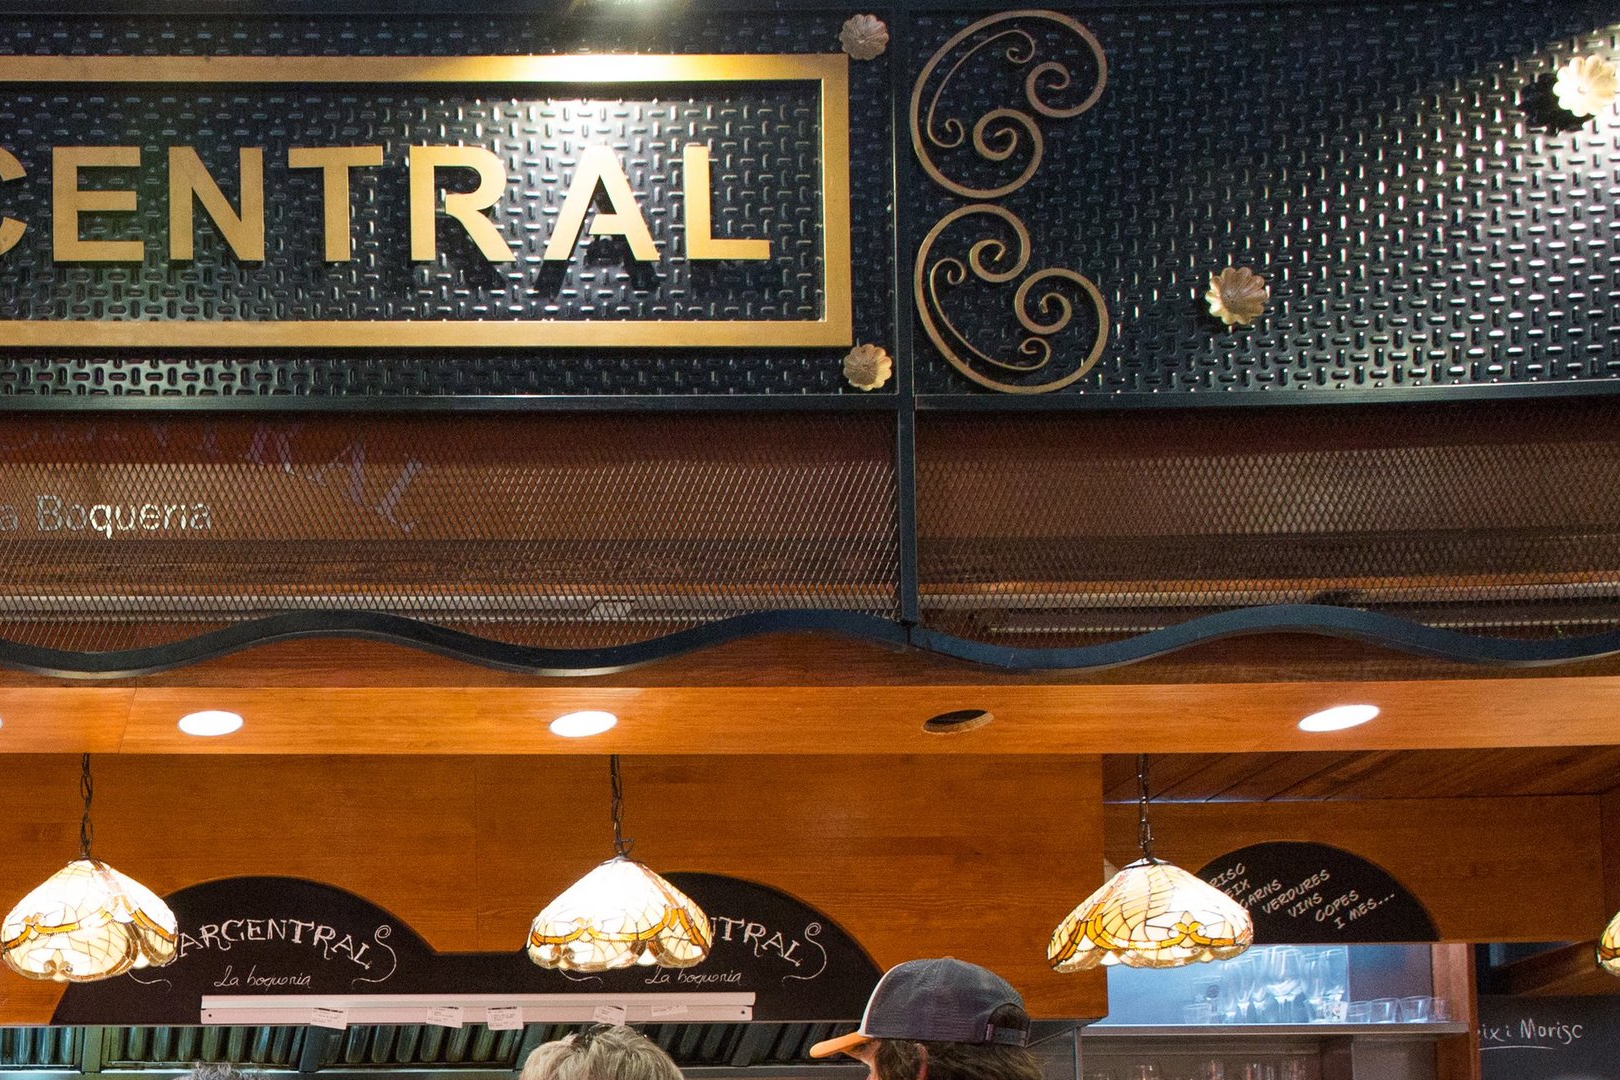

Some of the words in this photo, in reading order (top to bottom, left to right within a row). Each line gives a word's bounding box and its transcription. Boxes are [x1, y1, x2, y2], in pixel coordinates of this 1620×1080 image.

[35, 494, 213, 540] Boqueria
[1262, 869, 1331, 915] VERDURES
[1287, 892, 1323, 919] VINS
[1315, 890, 1360, 922] COPES
[178, 918, 373, 970] ARCENTRAL
